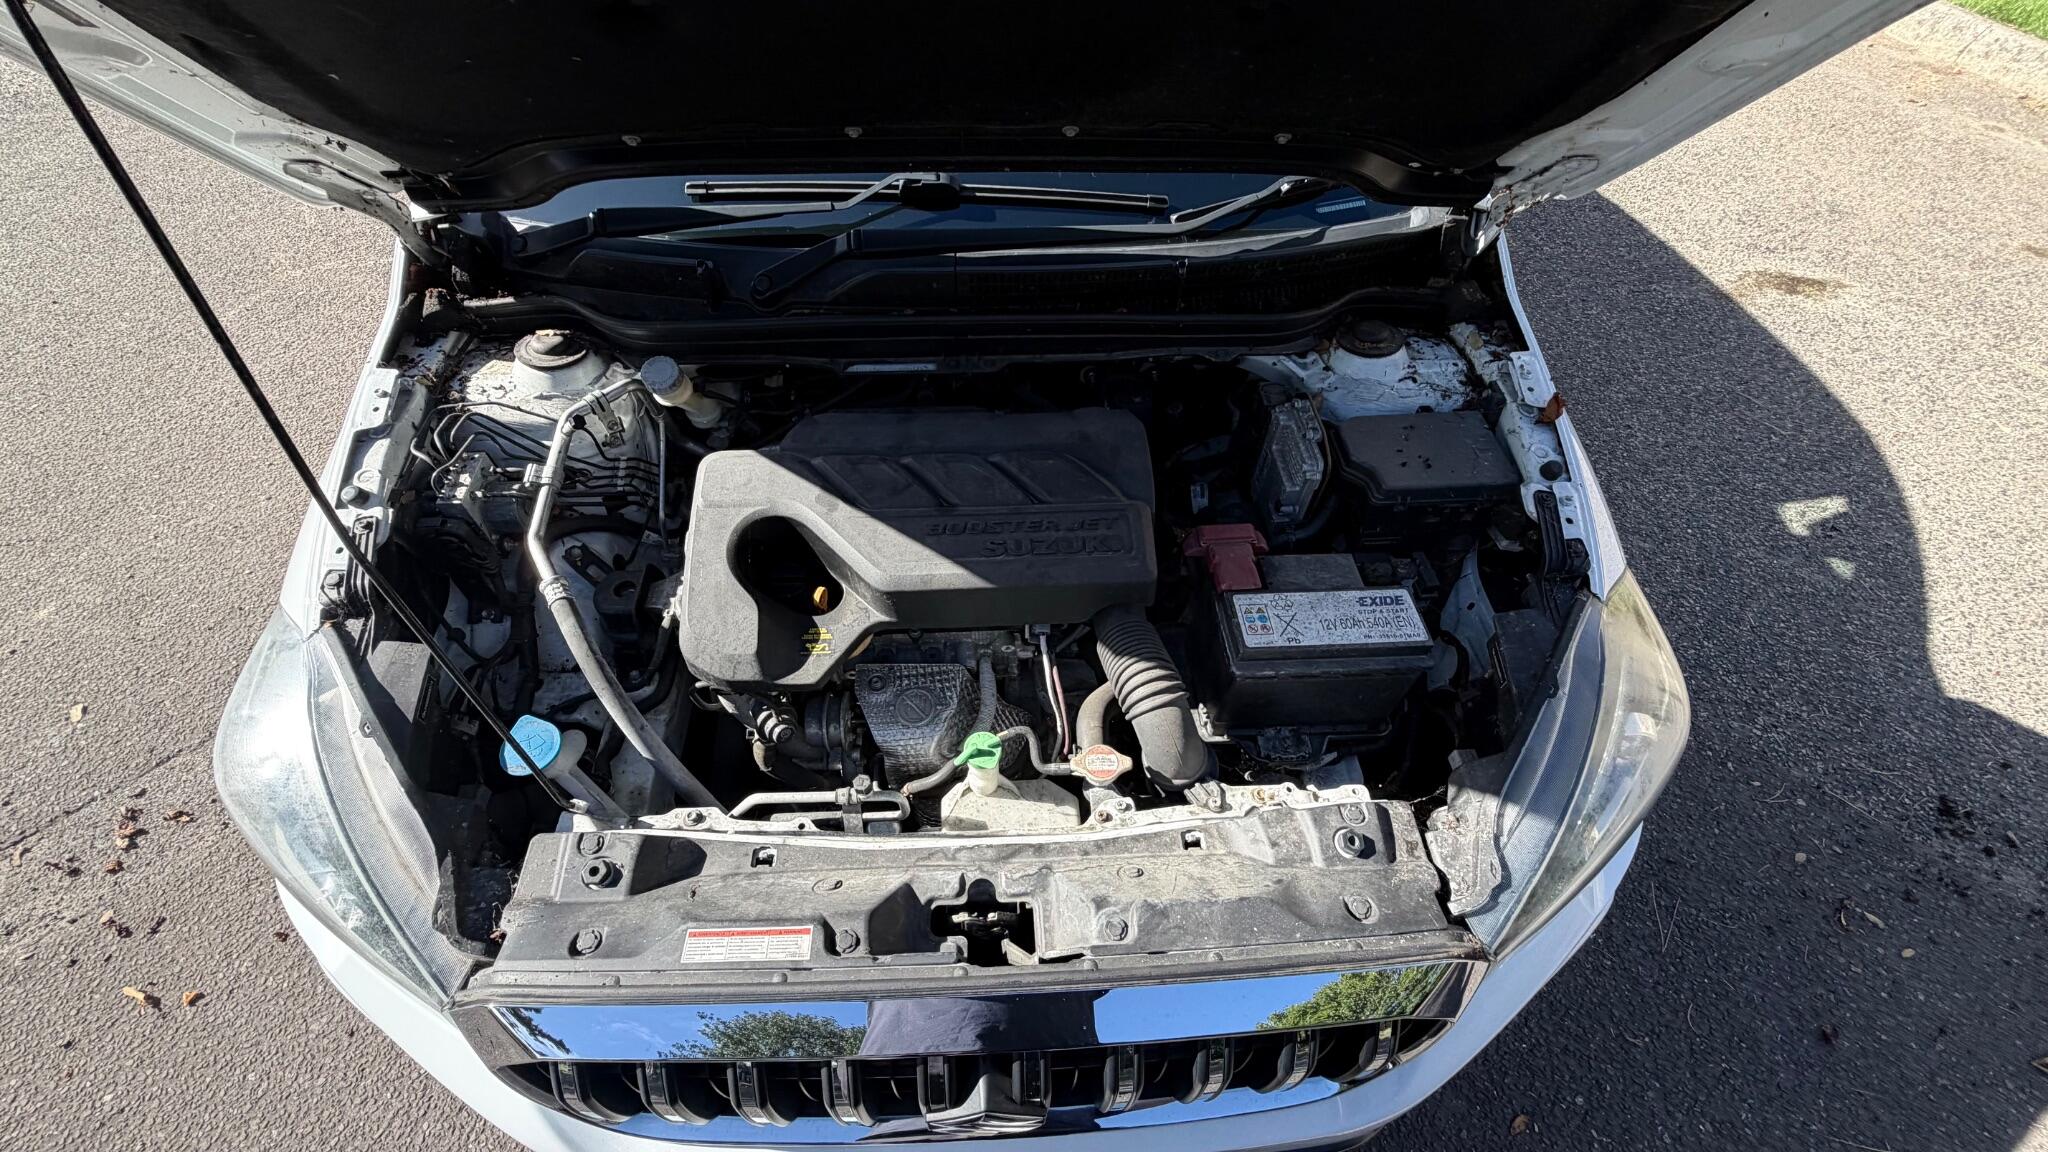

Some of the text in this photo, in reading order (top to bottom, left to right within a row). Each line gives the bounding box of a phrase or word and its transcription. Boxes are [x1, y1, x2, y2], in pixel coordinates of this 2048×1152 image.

[983, 536, 1123, 557] SUZUKI
[1356, 596, 1404, 606] EXIDE
[1320, 619, 1337, 631] 12V
[1340, 617, 1365, 630] 60Ah
[1366, 617, 1392, 629] 540A
[1287, 637, 1301, 645] Pb
